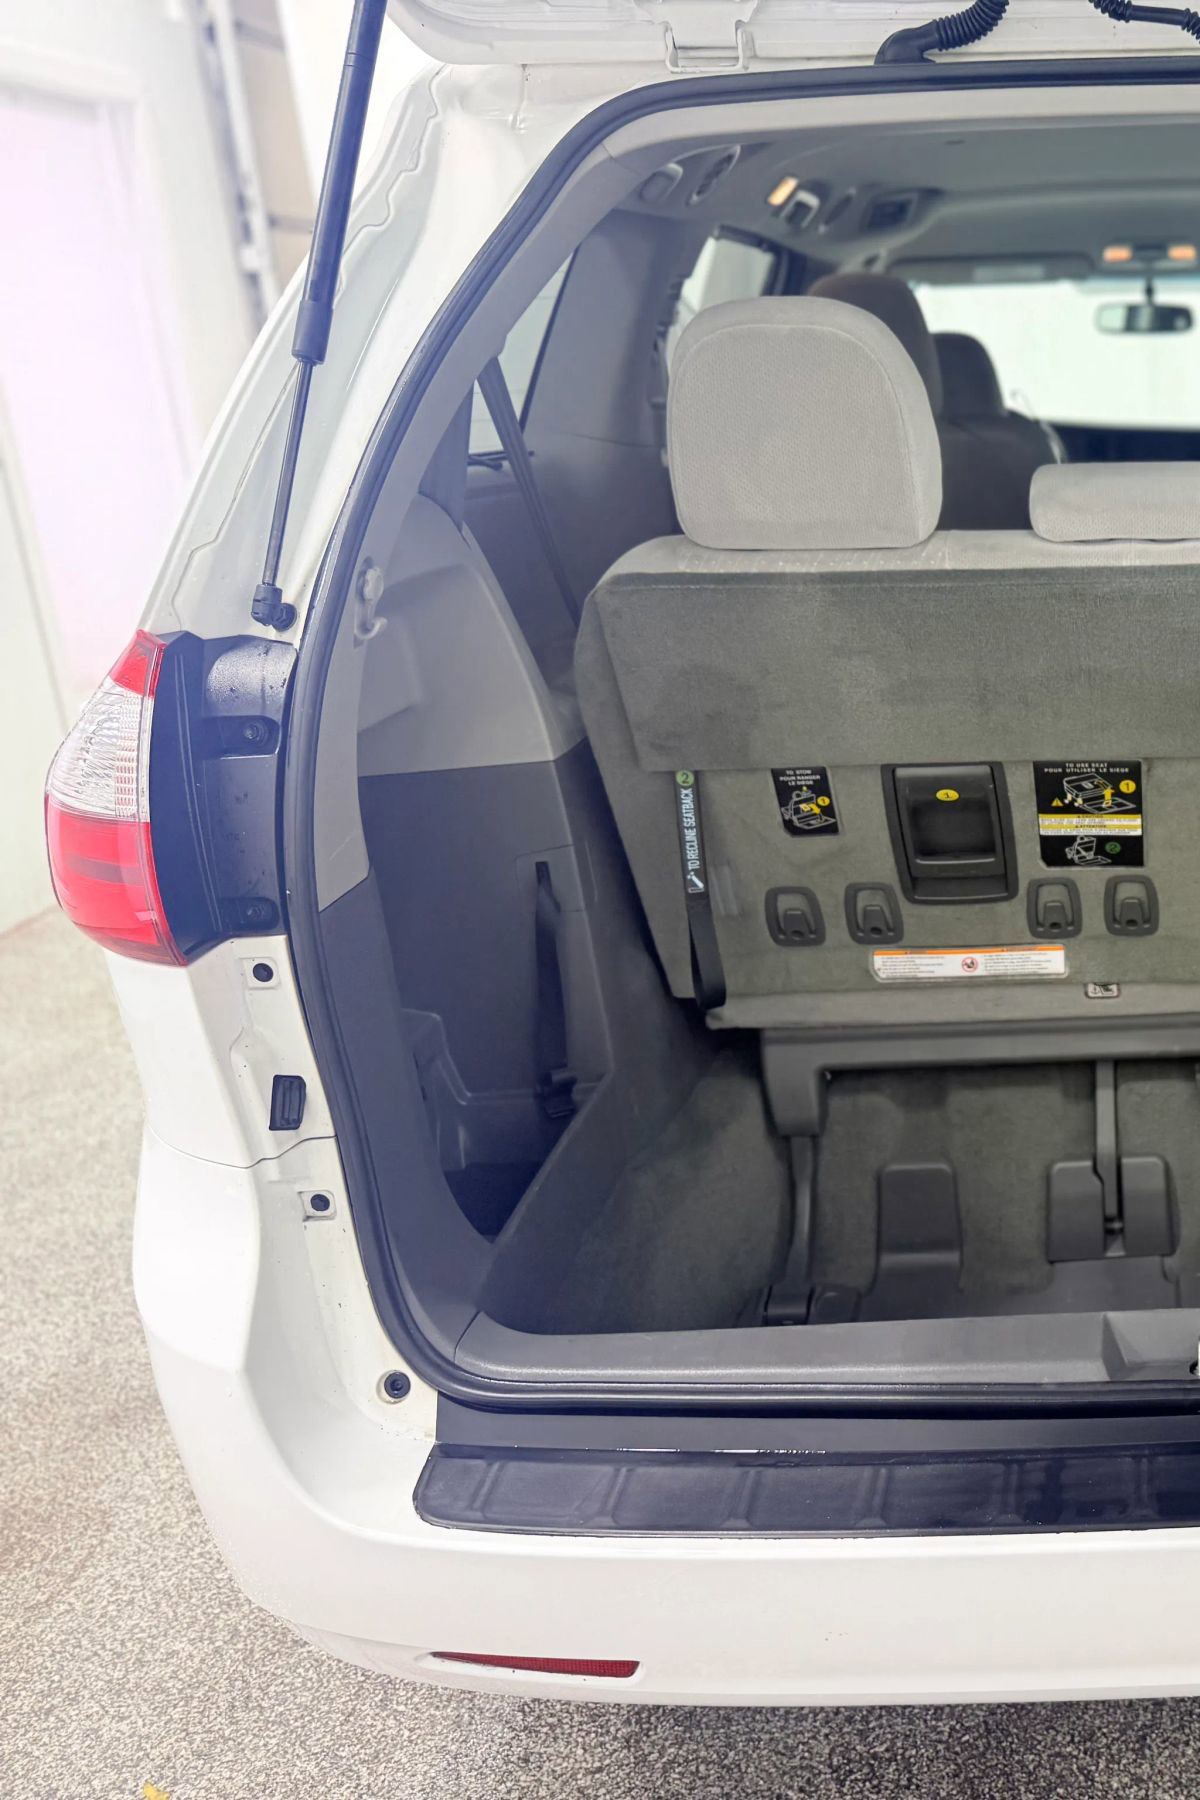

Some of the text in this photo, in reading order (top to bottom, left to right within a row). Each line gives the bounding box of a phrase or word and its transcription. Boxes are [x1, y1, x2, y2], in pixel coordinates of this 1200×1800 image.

[680, 788, 700, 870] TO RECLINE SEATBACK
